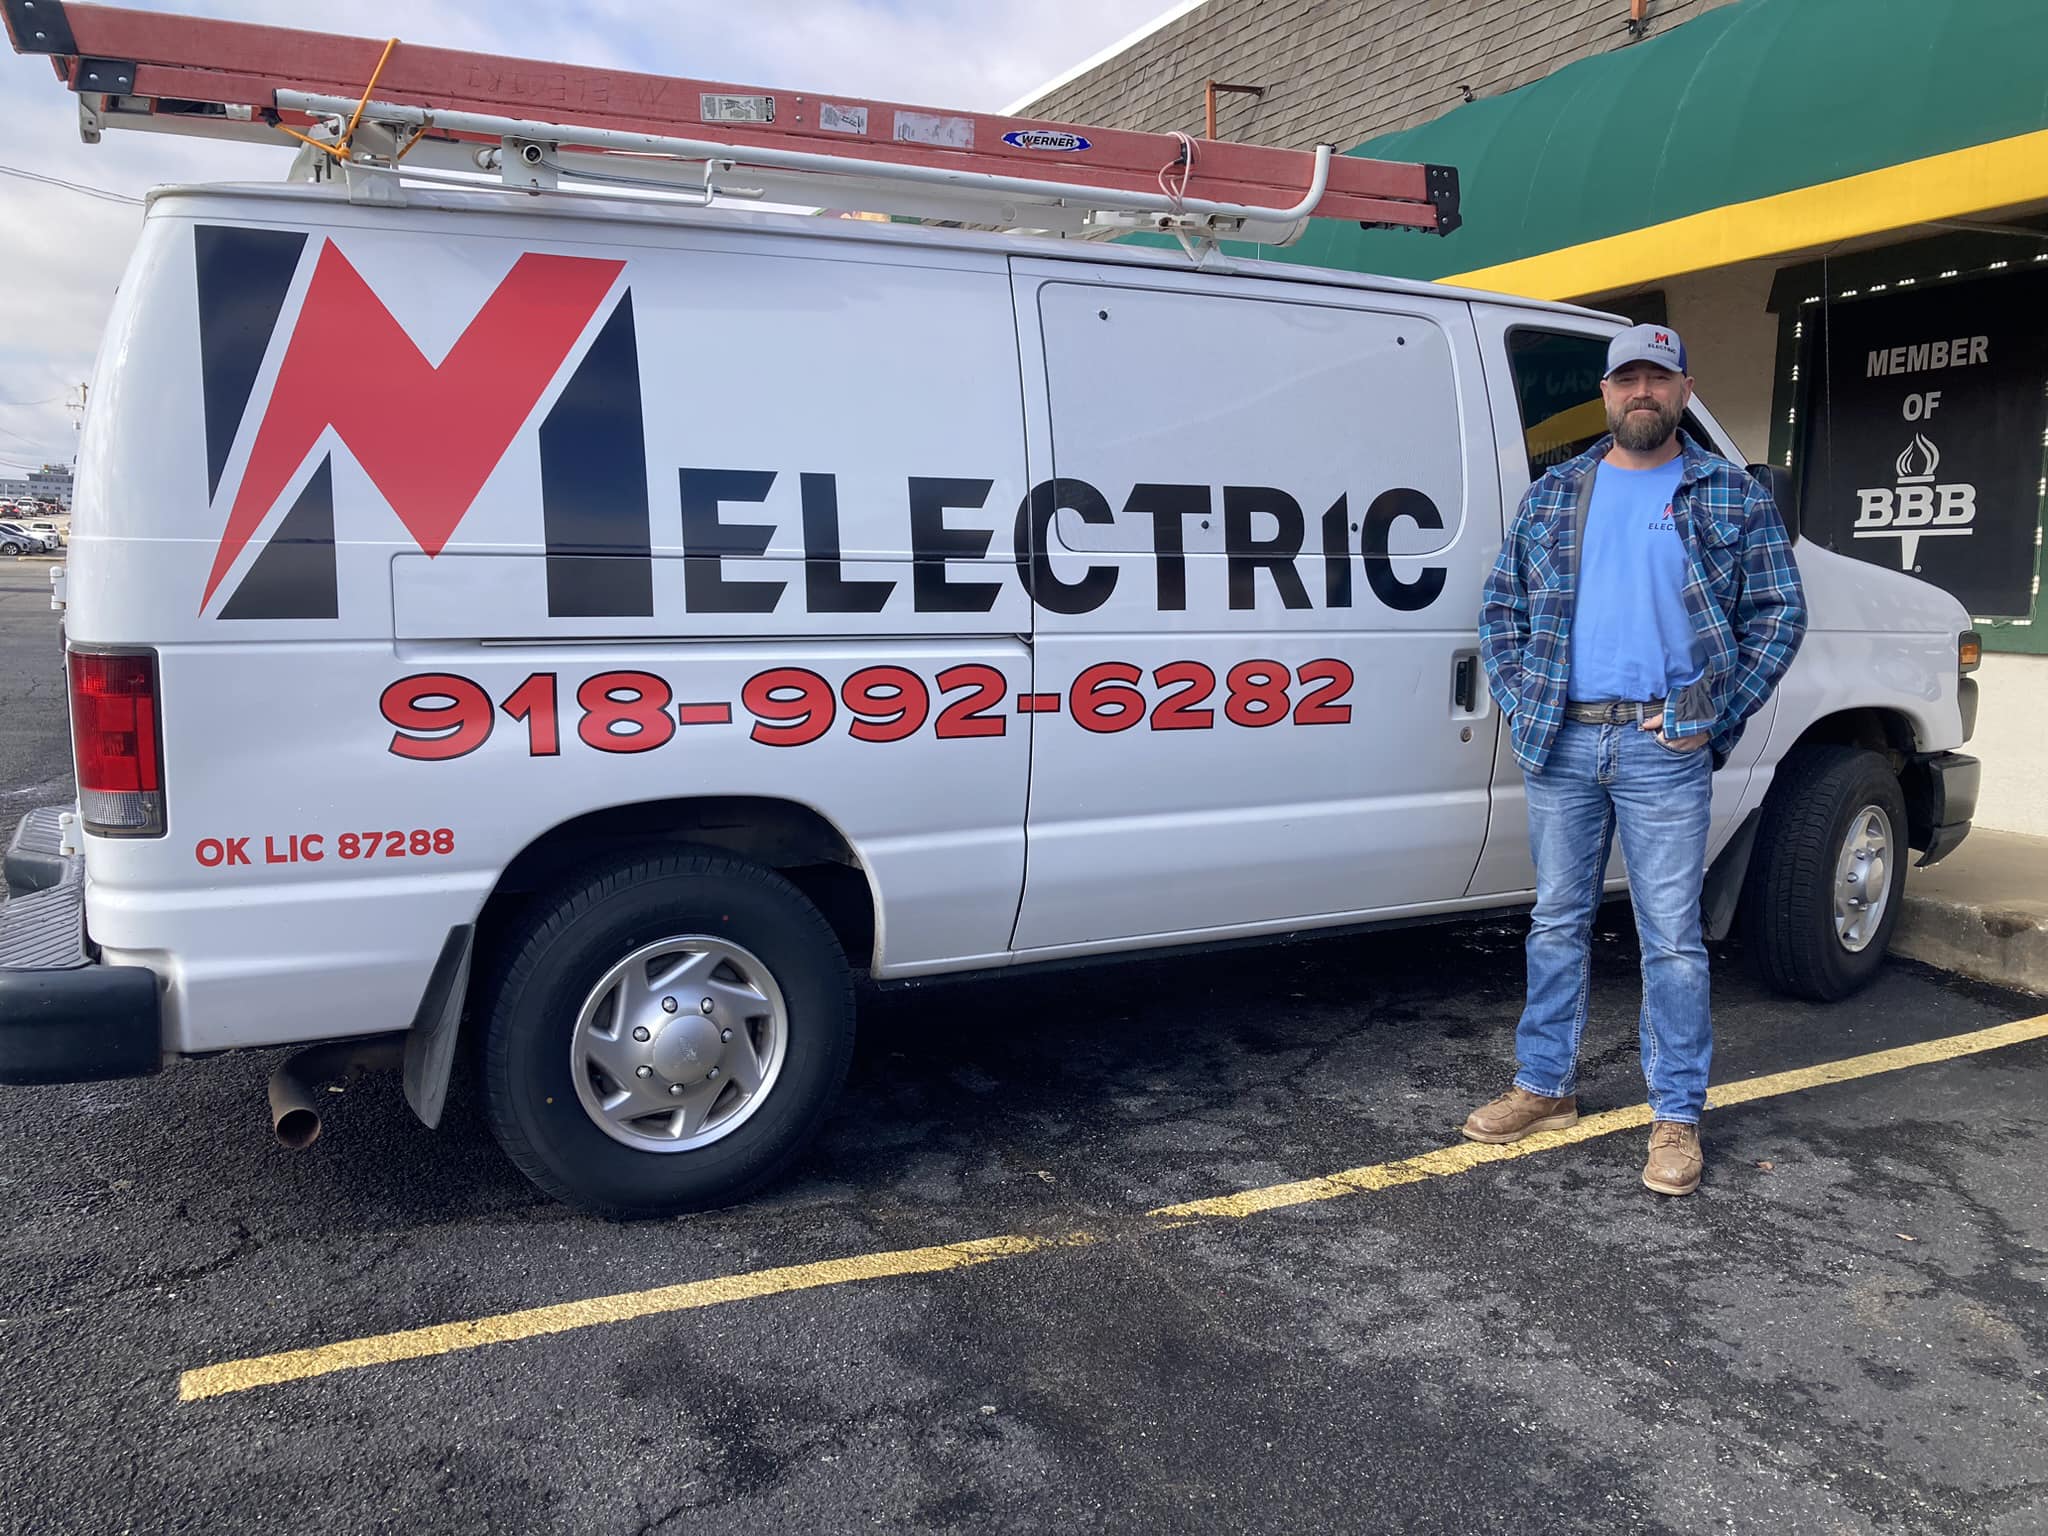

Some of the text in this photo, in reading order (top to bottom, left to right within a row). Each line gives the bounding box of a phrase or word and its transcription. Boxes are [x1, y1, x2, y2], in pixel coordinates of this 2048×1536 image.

[1021, 135, 1076, 148] WERNER
[1654, 331, 1669, 346] M
[1866, 335, 1990, 378] MEMBER
[194, 223, 1448, 621] M ELECTRIC
[1902, 391, 1942, 421] OF
[1854, 483, 1977, 528] BBB
[1648, 522, 1678, 531] ELEC
[379, 657, 1355, 761] 918-992-6282
[195, 827, 455, 867] OK LIC 87288
